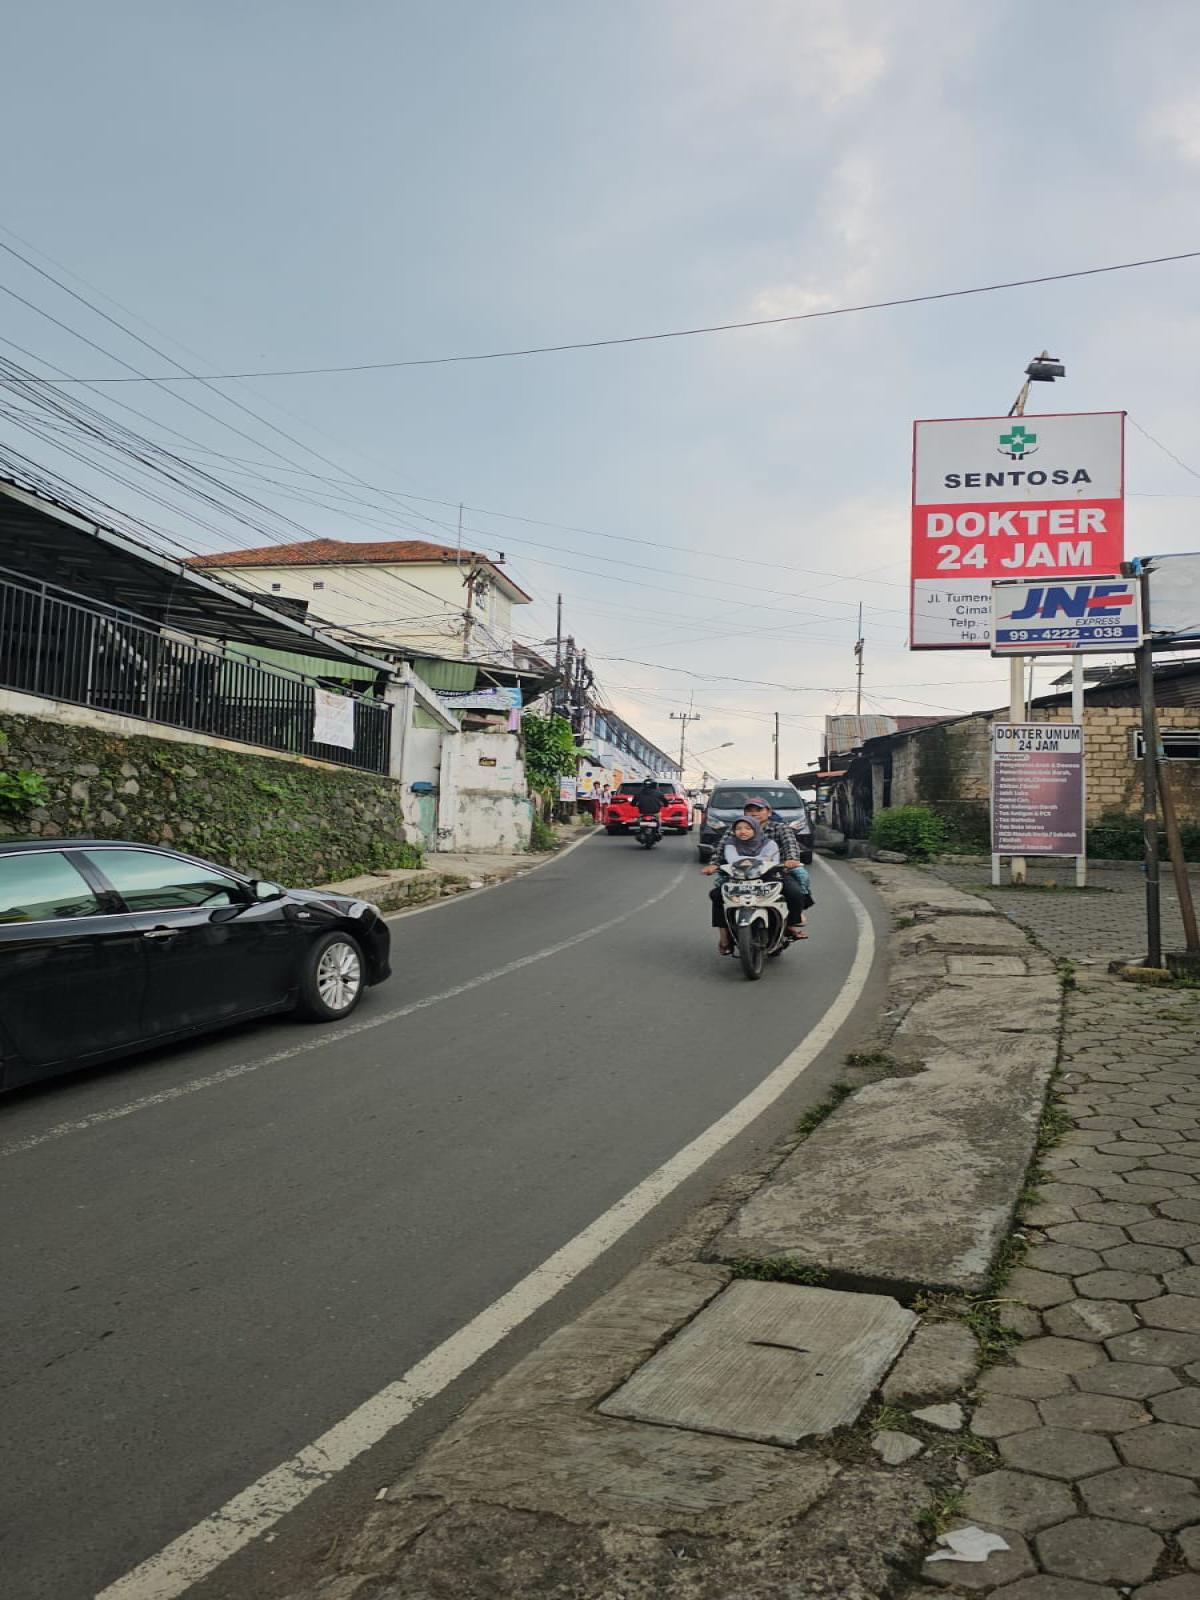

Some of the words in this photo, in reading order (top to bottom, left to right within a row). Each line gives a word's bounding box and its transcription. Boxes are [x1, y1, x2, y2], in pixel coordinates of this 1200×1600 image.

[944, 468, 1092, 489] SENTOSA
[927, 507, 1107, 539] DOKTER
[936, 544, 988, 570] 24
[1001, 541, 1093, 569] JAM
[1009, 584, 1134, 620] JNE
[1075, 617, 1121, 626] EXPRESS
[1009, 630, 1029, 641] 99
[1041, 629, 1080, 640] 4222
[1093, 627, 1123, 638] 038
[997, 729, 1042, 739] DOKTER
[1045, 729, 1080, 739] UMUM
[1019, 740, 1032, 751] 24
[1035, 741, 1059, 751] JAM
